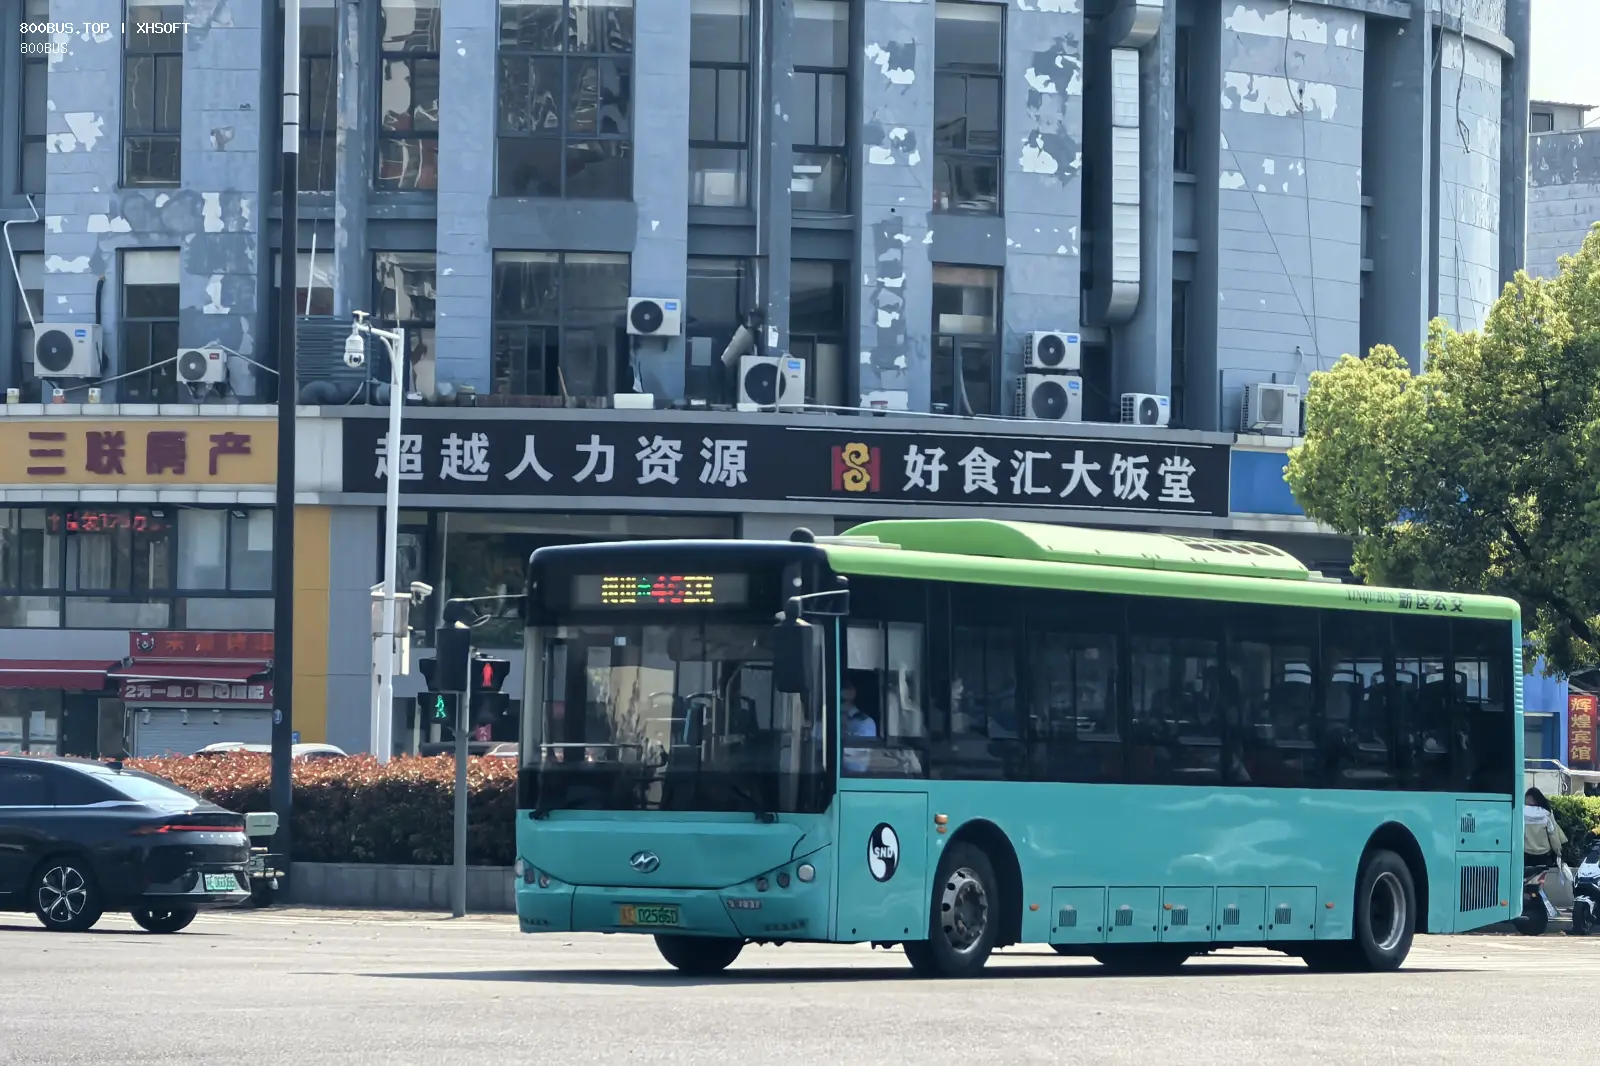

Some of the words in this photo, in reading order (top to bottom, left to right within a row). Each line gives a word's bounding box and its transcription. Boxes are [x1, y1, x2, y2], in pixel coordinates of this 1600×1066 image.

[374, 431, 749, 488] 超越人力资源
[902, 444, 1198, 503] 好食汇大饭堂
[1398, 592, 1464, 613] 新区公交
[1570, 697, 1593, 762] 辉煌宾馆
[874, 846, 894, 859] SND
